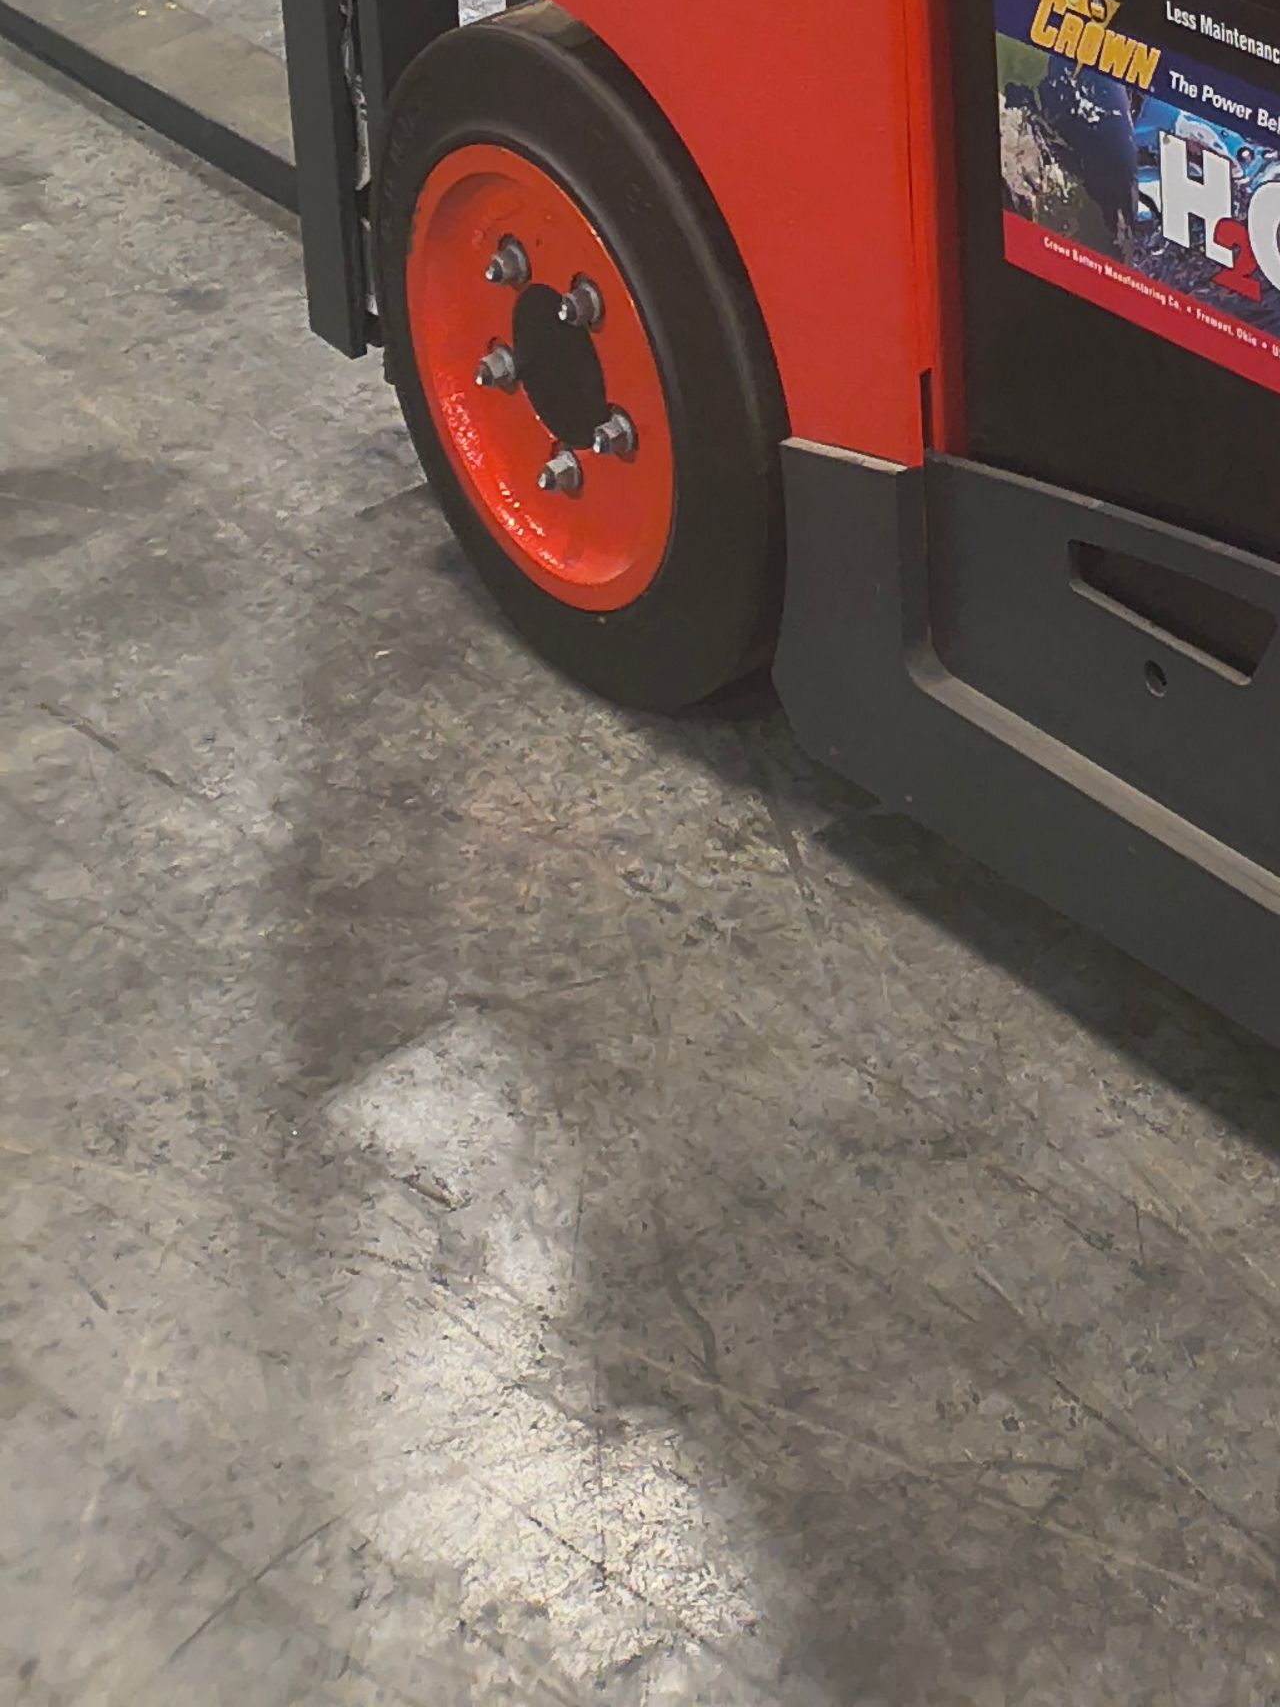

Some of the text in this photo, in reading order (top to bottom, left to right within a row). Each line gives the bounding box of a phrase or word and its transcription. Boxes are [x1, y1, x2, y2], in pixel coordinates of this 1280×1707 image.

[1165, 0, 1197, 31] Less
[1168, 70, 1198, 98] The
[1201, 84, 1253, 120] Power
